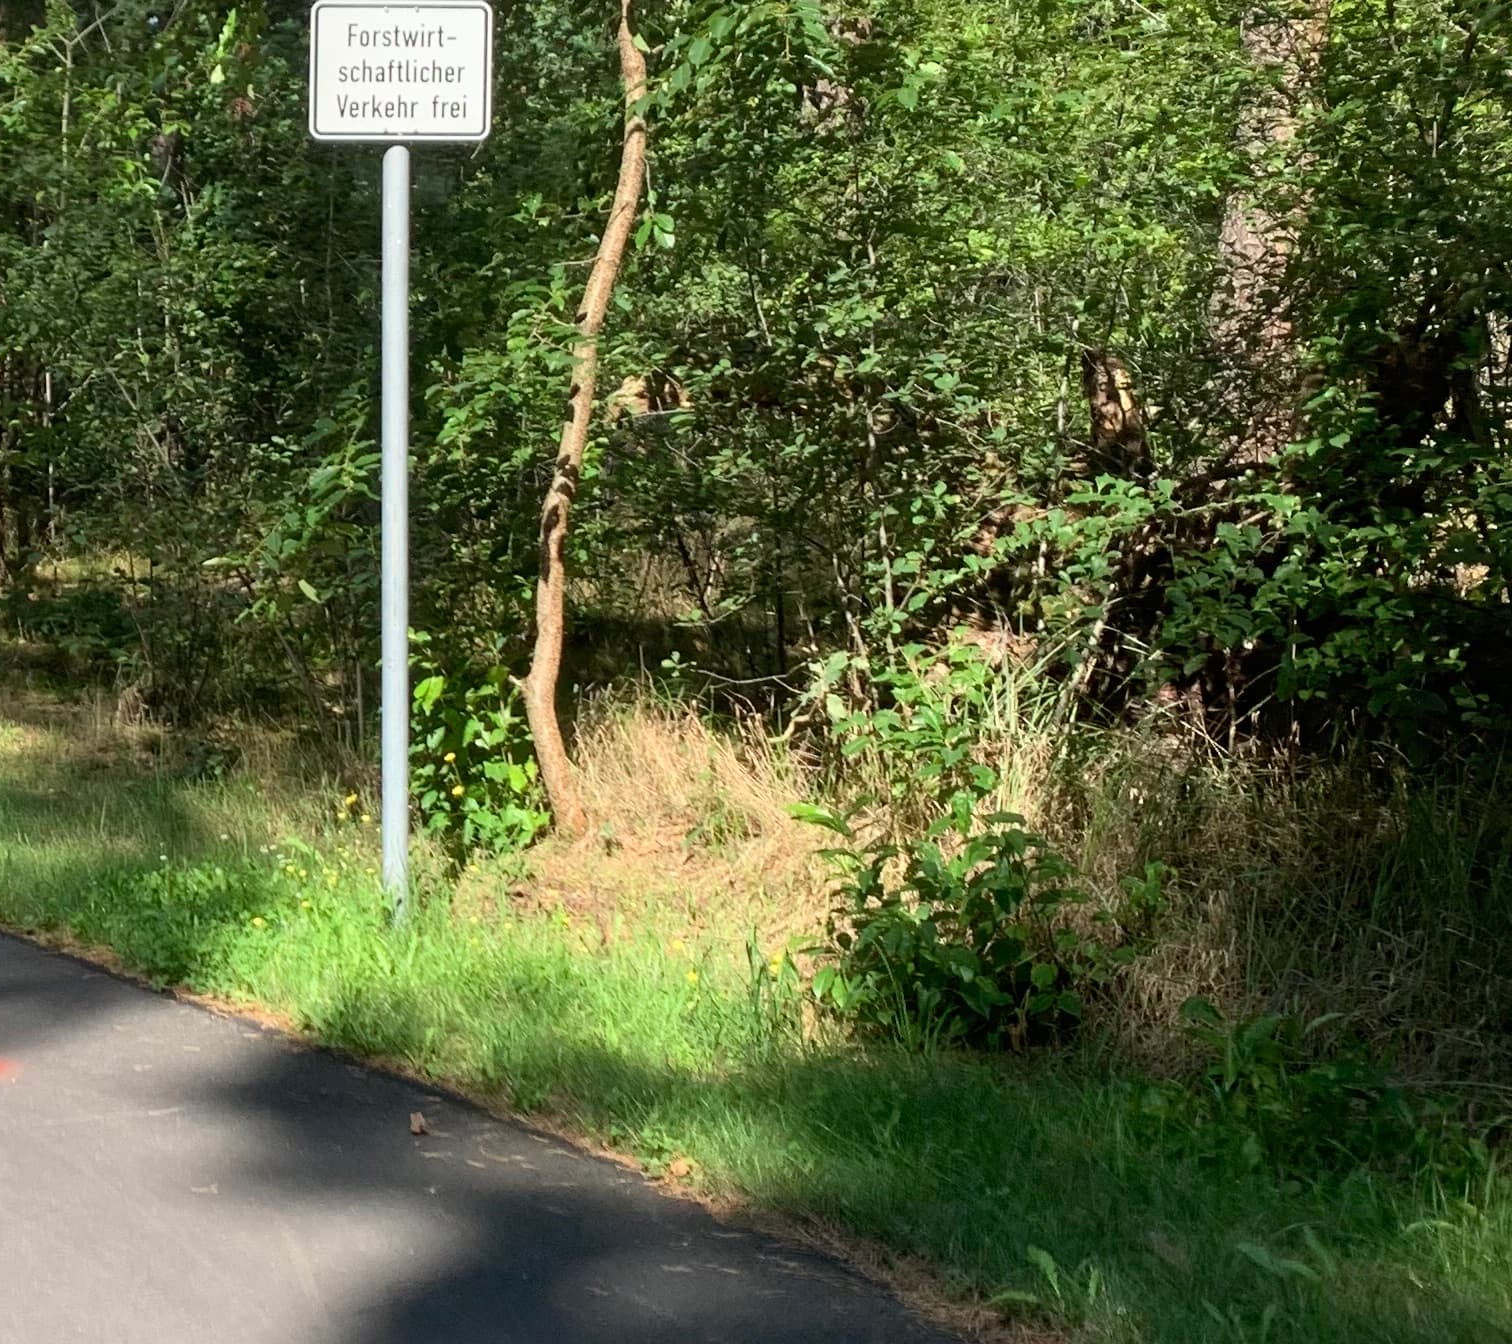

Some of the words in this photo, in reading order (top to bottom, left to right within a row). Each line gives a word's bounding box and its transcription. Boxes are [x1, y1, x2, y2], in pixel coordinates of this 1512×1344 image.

[347, 23, 457, 48] Forstwirt-
[338, 60, 465, 83] schaftlicher
[337, 94, 419, 119] Verkehr
[432, 94, 468, 119] frei
